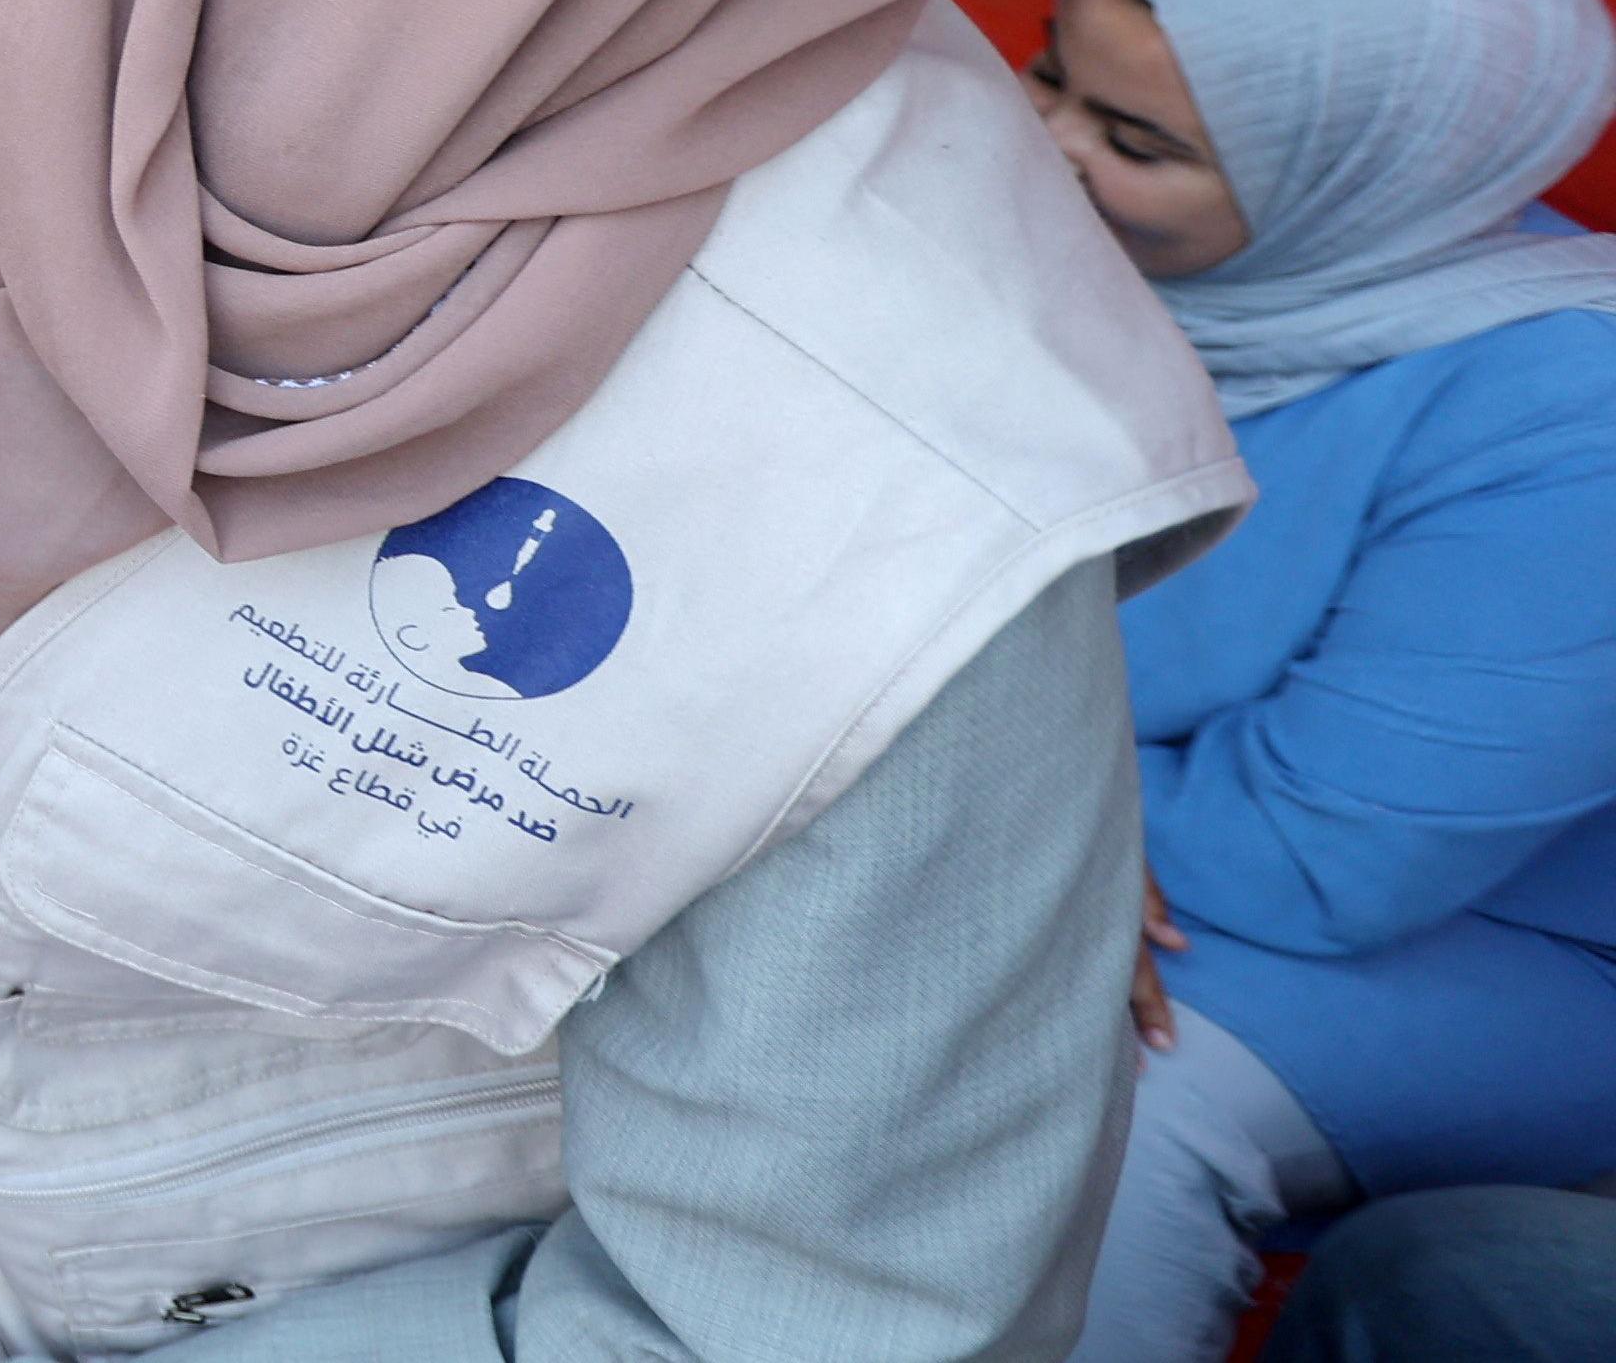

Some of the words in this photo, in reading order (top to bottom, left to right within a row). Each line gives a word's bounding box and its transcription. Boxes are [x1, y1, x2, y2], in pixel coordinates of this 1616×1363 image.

[229, 604, 346, 672] للتطعيم
[244, 663, 355, 734] الأطفال
[282, 732, 325, 773] غزة
[352, 728, 428, 768] شلل
[328, 768, 416, 811] قطاع
[432, 766, 504, 811] مرض
[417, 810, 462, 840] في
[508, 811, 557, 842] ضد
